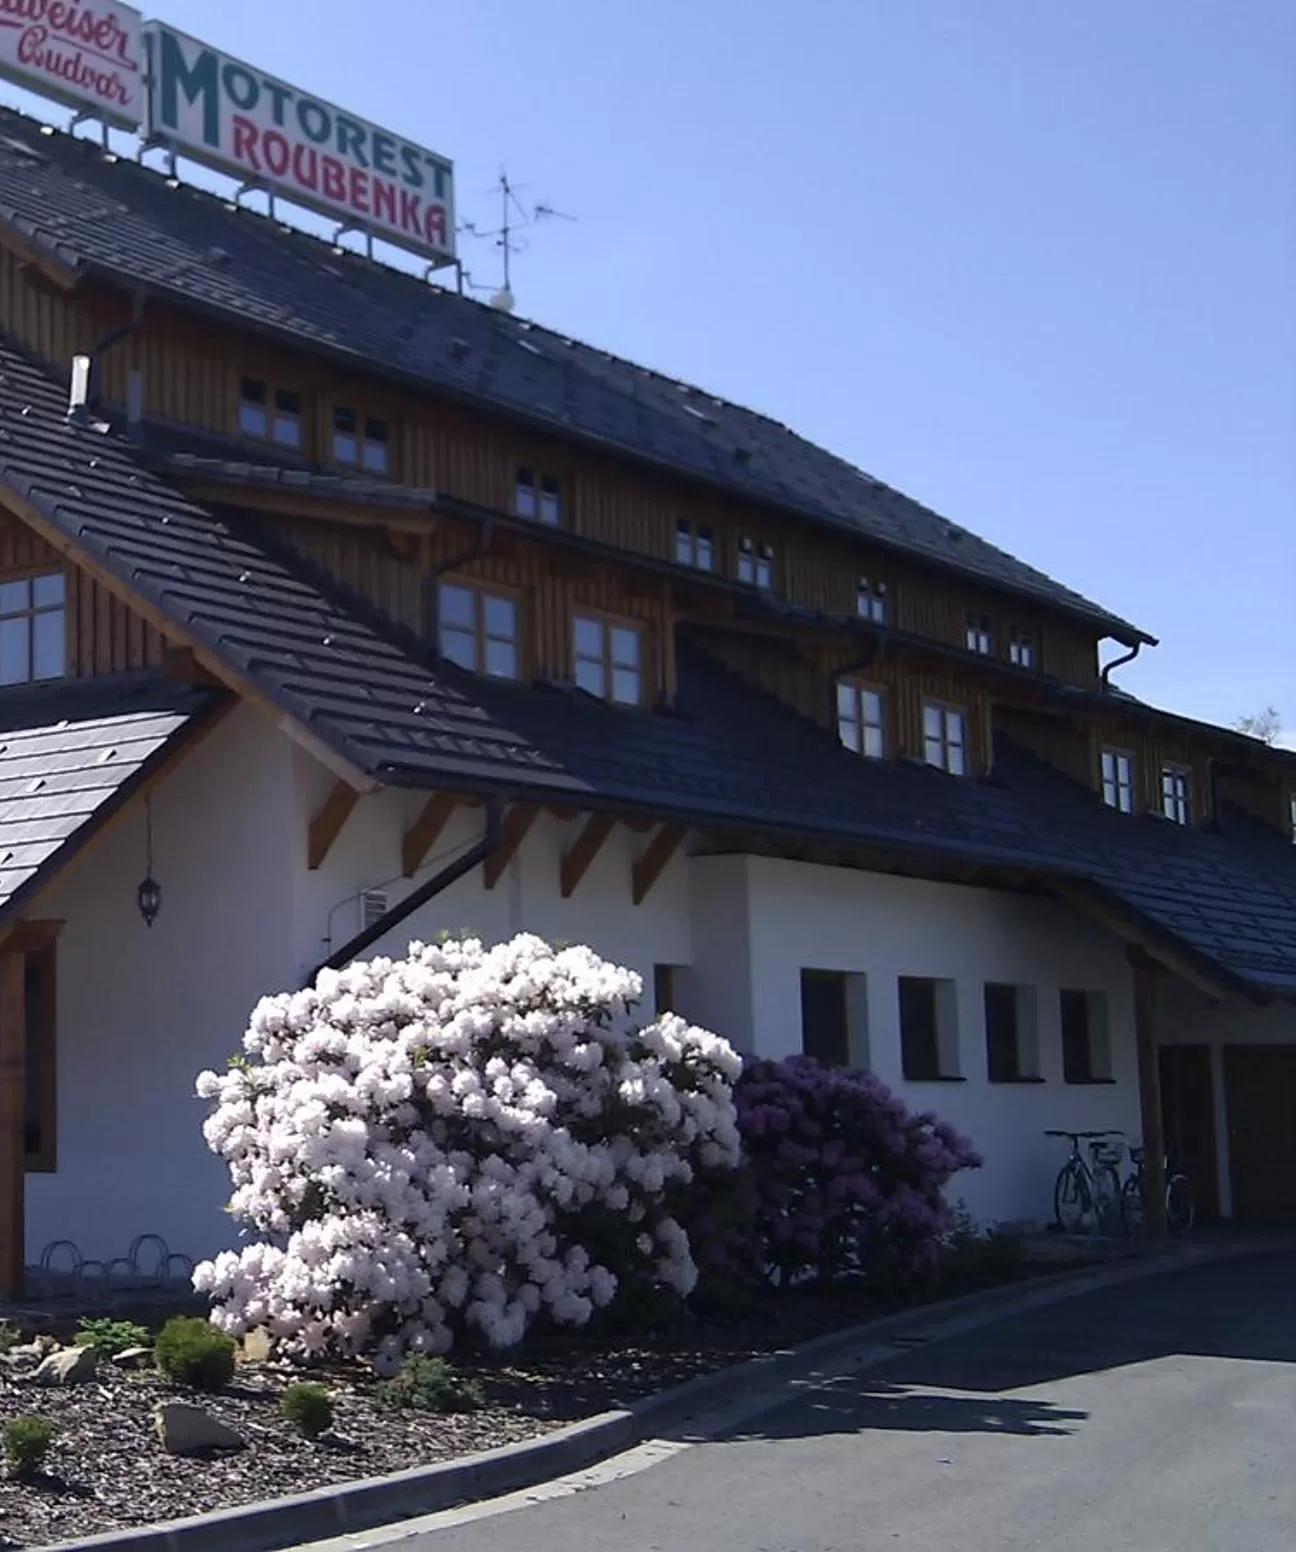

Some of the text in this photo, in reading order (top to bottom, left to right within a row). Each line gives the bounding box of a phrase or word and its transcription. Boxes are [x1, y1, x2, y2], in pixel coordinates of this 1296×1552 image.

[17, 25, 133, 105] Budvar
[160, 30, 452, 199] MOTOREST
[232, 114, 447, 247] ROUBENKA
